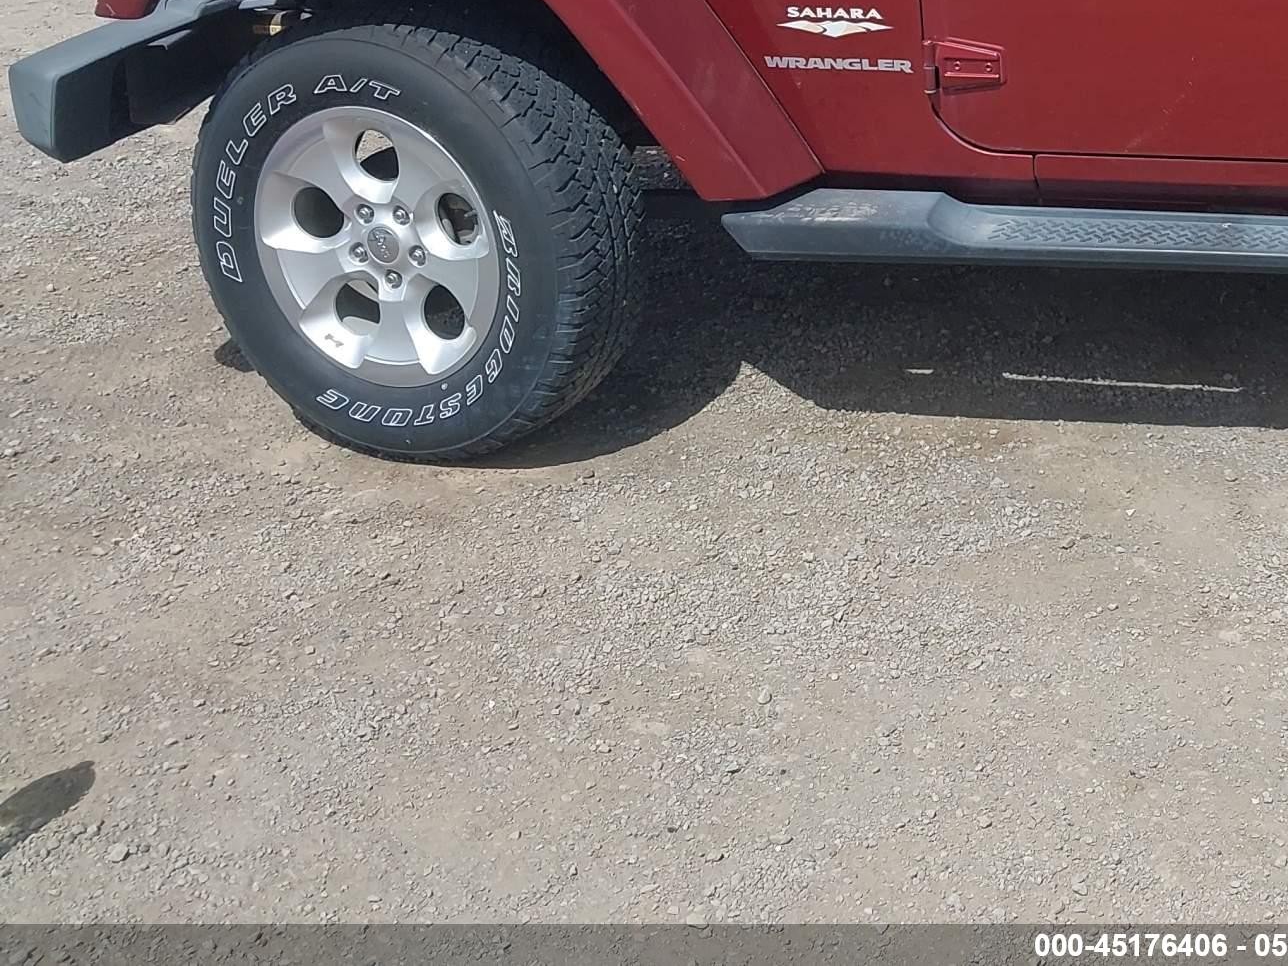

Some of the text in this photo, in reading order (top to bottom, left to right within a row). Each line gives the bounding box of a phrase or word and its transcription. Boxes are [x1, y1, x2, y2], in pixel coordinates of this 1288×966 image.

[764, 55, 914, 74] WRANGLER
[787, 6, 883, 20] SAHARA
[213, 74, 401, 283] DUELER A/T
[316, 210, 521, 427] BRIDGESTONE
